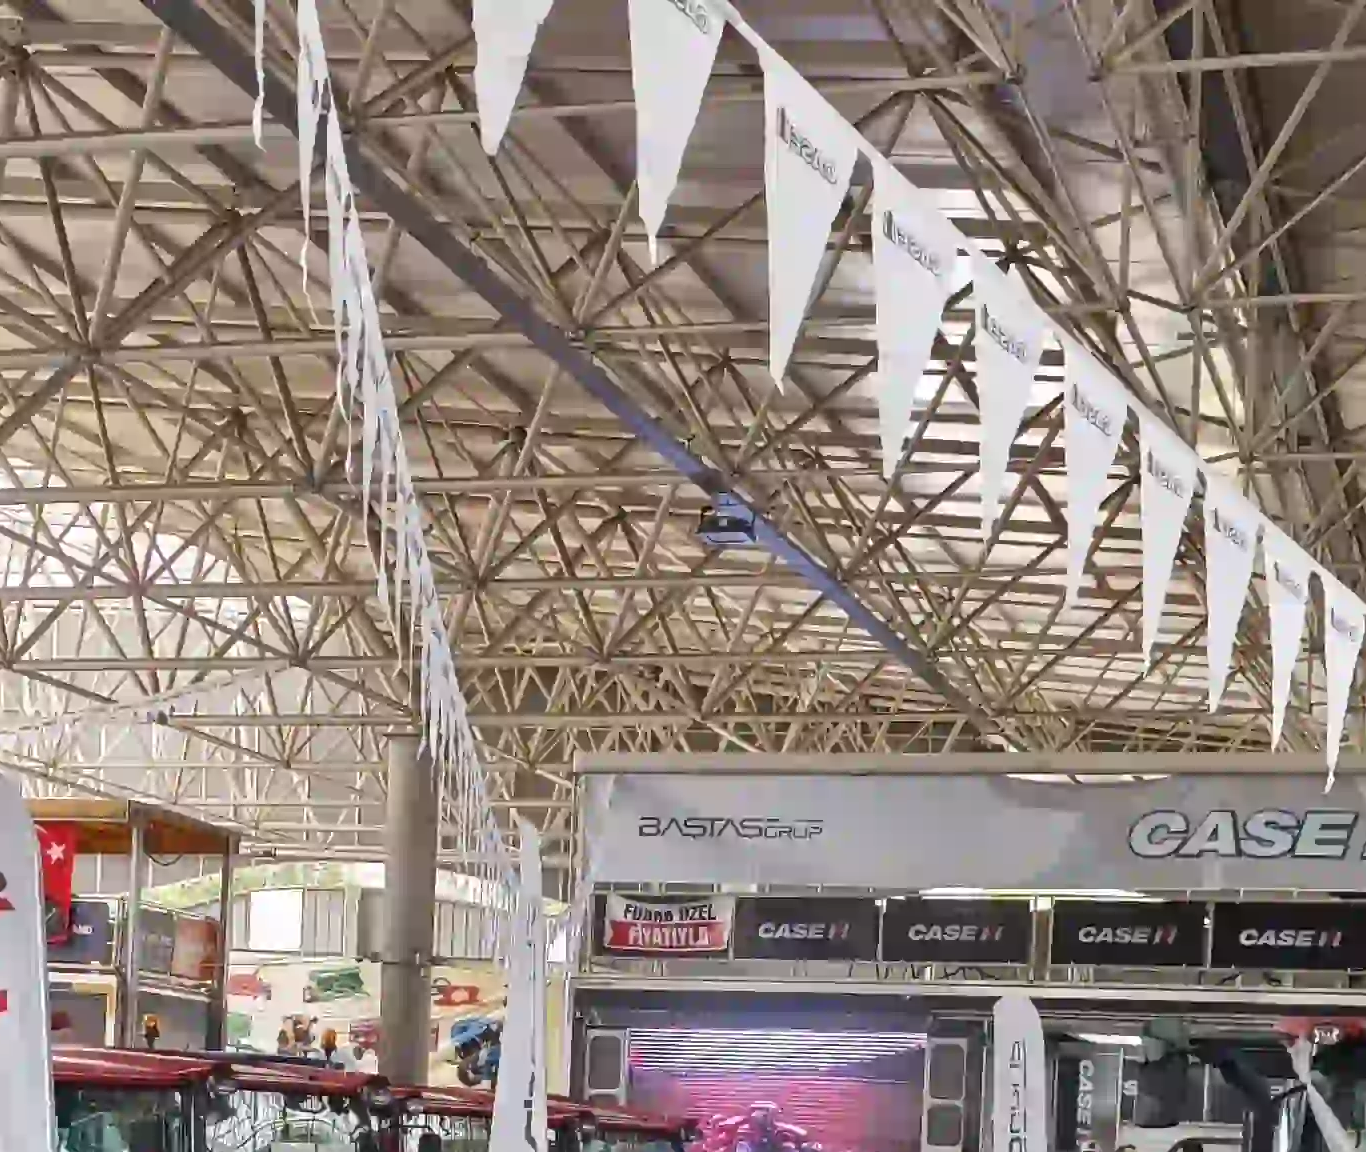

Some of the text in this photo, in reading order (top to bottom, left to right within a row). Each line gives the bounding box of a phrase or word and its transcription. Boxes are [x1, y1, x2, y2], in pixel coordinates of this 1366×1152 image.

[1129, 809, 1359, 859] CASE
[758, 922, 824, 940] CASE
[908, 924, 978, 943] CASE
[1078, 926, 1150, 945] CASE
[1239, 929, 1314, 948] CASE
[1077, 1059, 1095, 1125] CASE
